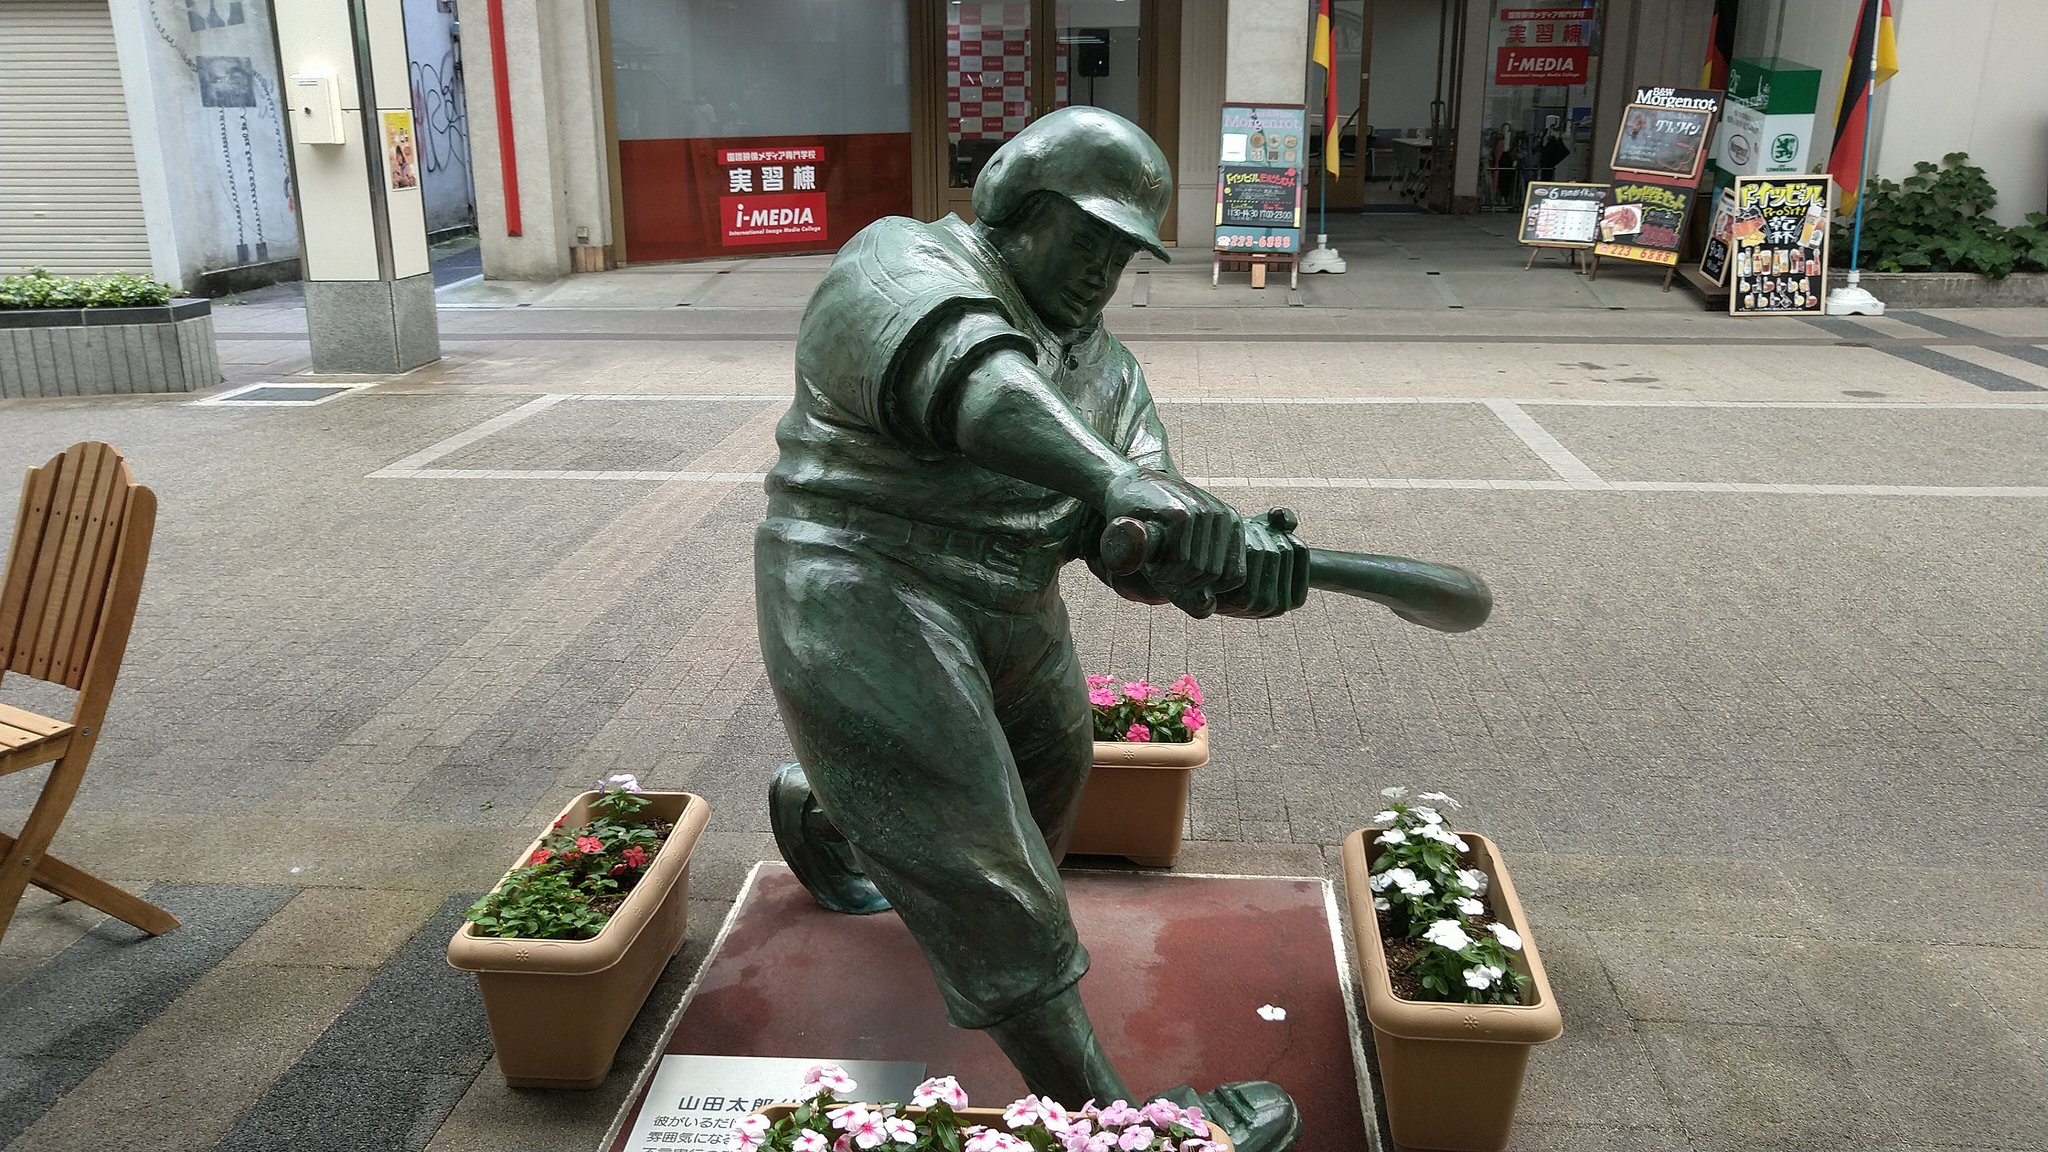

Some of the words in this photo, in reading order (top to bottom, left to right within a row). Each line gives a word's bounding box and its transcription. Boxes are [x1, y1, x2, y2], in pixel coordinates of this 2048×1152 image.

[1507, 24, 1582, 43] 実習棟
[1507, 52, 1574, 71] i-MEDIA
[729, 165, 816, 193] 実習棟
[736, 203, 814, 228] i-MEDIA
[1230, 235, 1291, 249] 223-6888
